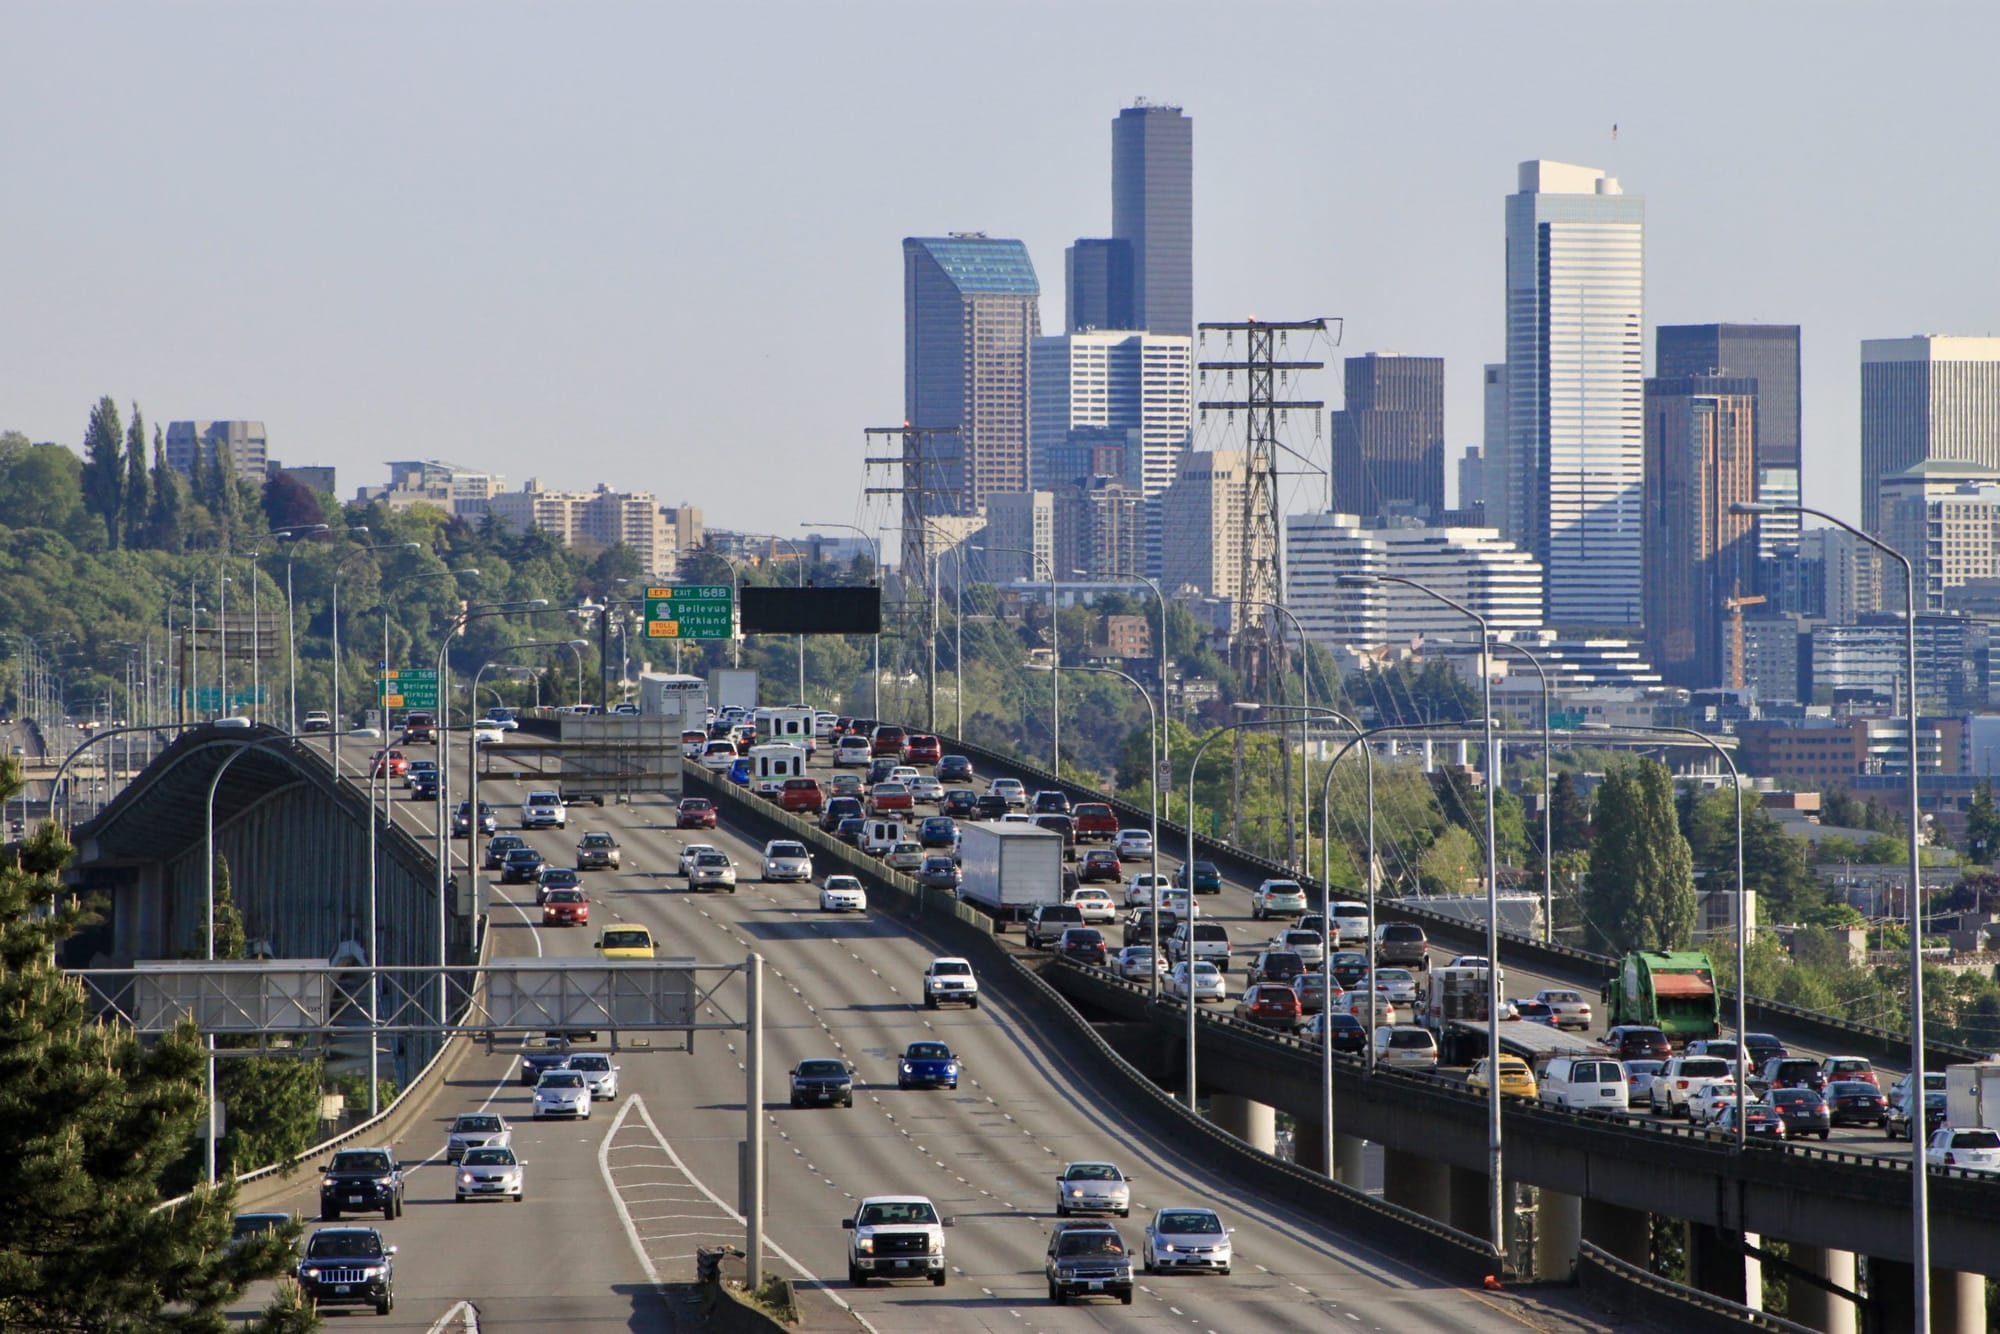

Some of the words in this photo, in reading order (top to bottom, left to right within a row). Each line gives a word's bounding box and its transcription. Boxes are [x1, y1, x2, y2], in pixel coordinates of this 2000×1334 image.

[699, 588, 727, 598] 168B
[678, 604, 727, 613] Bellevue
[679, 616, 727, 625] Kirkland
